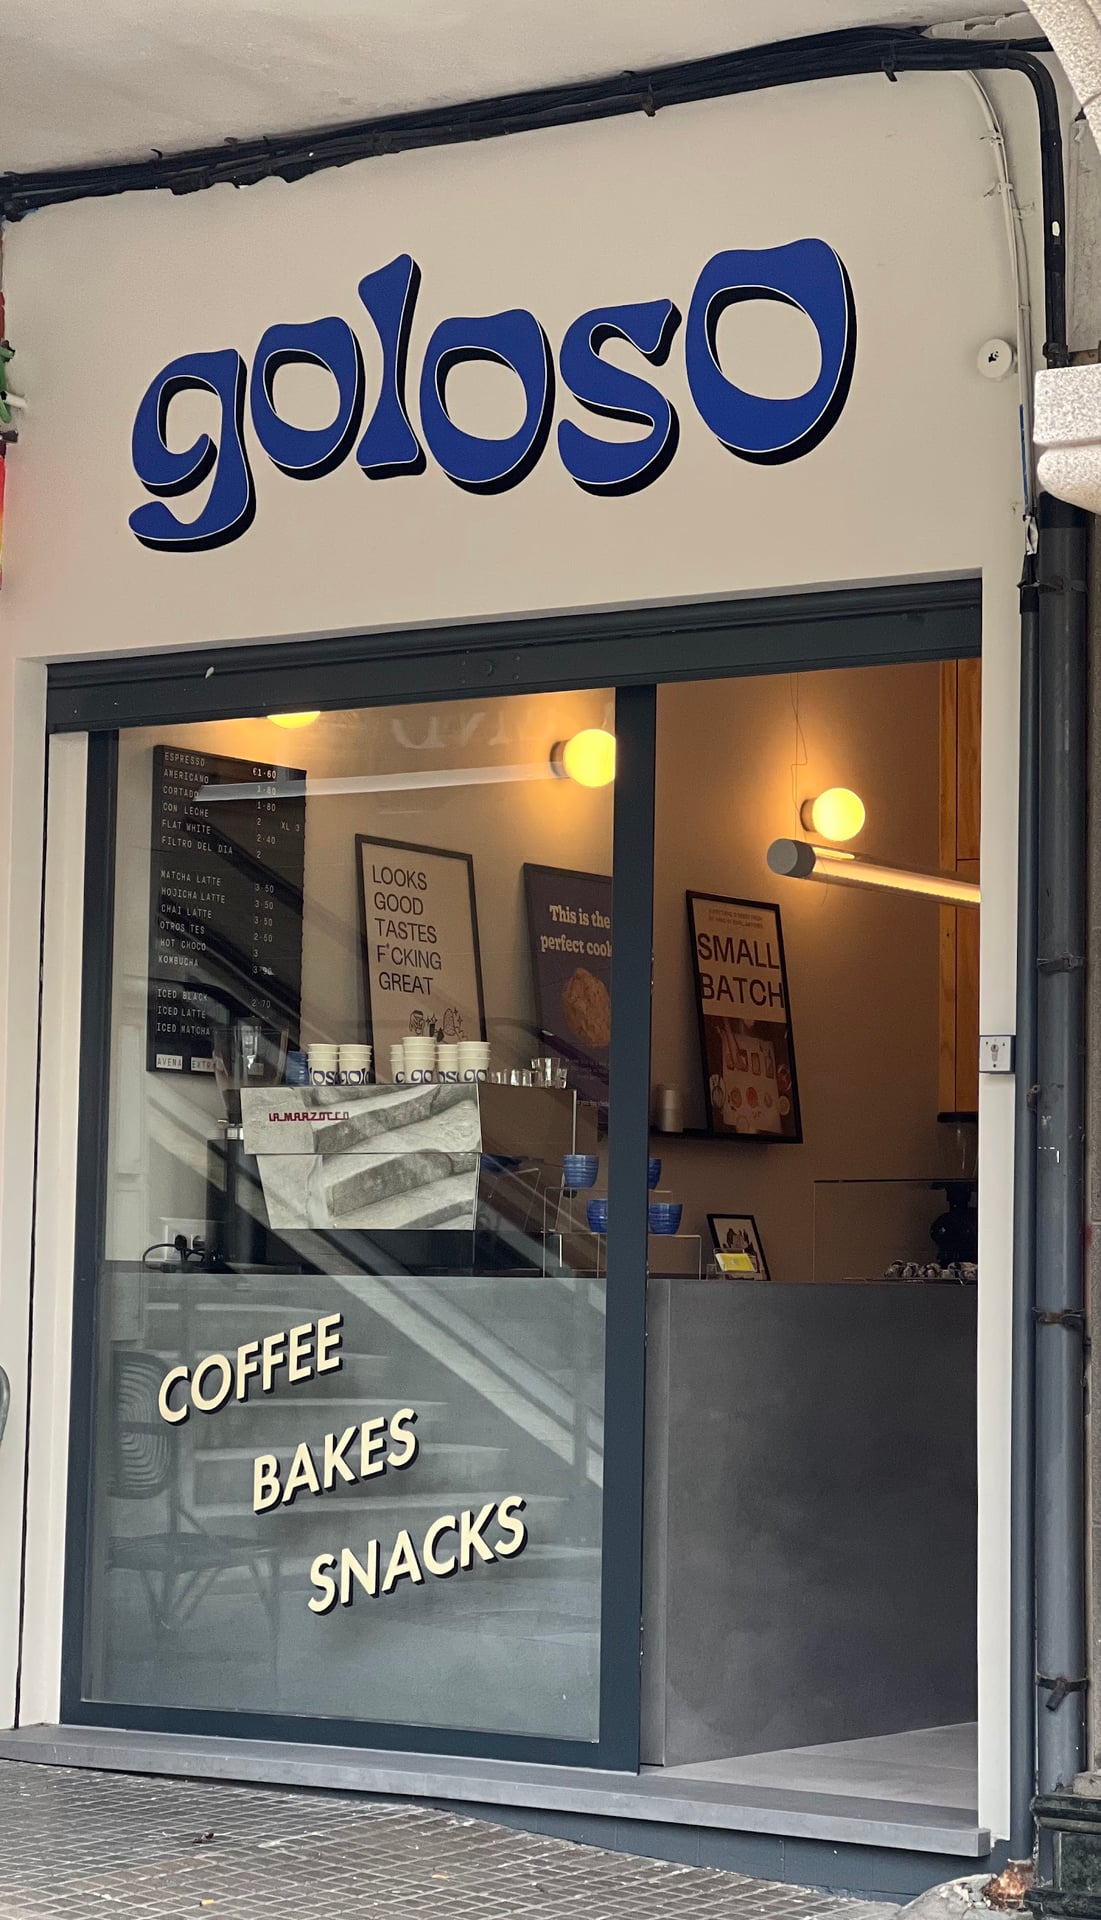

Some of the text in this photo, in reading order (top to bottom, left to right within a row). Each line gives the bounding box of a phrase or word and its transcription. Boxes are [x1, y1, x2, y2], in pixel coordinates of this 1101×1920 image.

[164, 751, 205, 767] ESPRESSO
[163, 768, 209, 785] AMERICANO
[162, 785, 199, 800] CORTADO
[162, 802, 300, 833] CON LECHE 2 XL 3
[162, 819, 182, 830] FLAT
[186, 823, 212, 836] WHITE
[161, 835, 262, 859] FILTRO DEL DIA 2
[160, 869, 191, 882] MATCHA
[196, 874, 222, 887] LATTE
[372, 864, 428, 891] LOOKS
[161, 887, 197, 900] HOJICHA
[200, 892, 226, 905] LATTE
[374, 892, 424, 915] GOOD
[161, 903, 182, 915] CHAI
[186, 907, 212, 920] LATTE
[549, 904, 611, 929] This is the
[160, 920, 186, 933] OTROS
[190, 924, 205, 935] TES
[374, 918, 437, 944] TASTES
[160, 938, 258, 958] HOT CHOCO 3
[540, 934, 585, 954] perfect
[698, 932, 780, 970] SMALL
[158, 954, 199, 968] KOMBUCHA
[379, 971, 434, 995] GREAT
[701, 972, 785, 1009] BATCH
[157, 988, 177, 999] ICED
[182, 990, 208, 1001] BLACK
[157, 1005, 207, 1019] ICED LATTE
[156, 1022, 211, 1036] ICED MATCHA
[158, 1312, 344, 1426] COFFEE
[252, 1408, 418, 1516] BAKES
[307, 1495, 527, 1616] SNACKS
